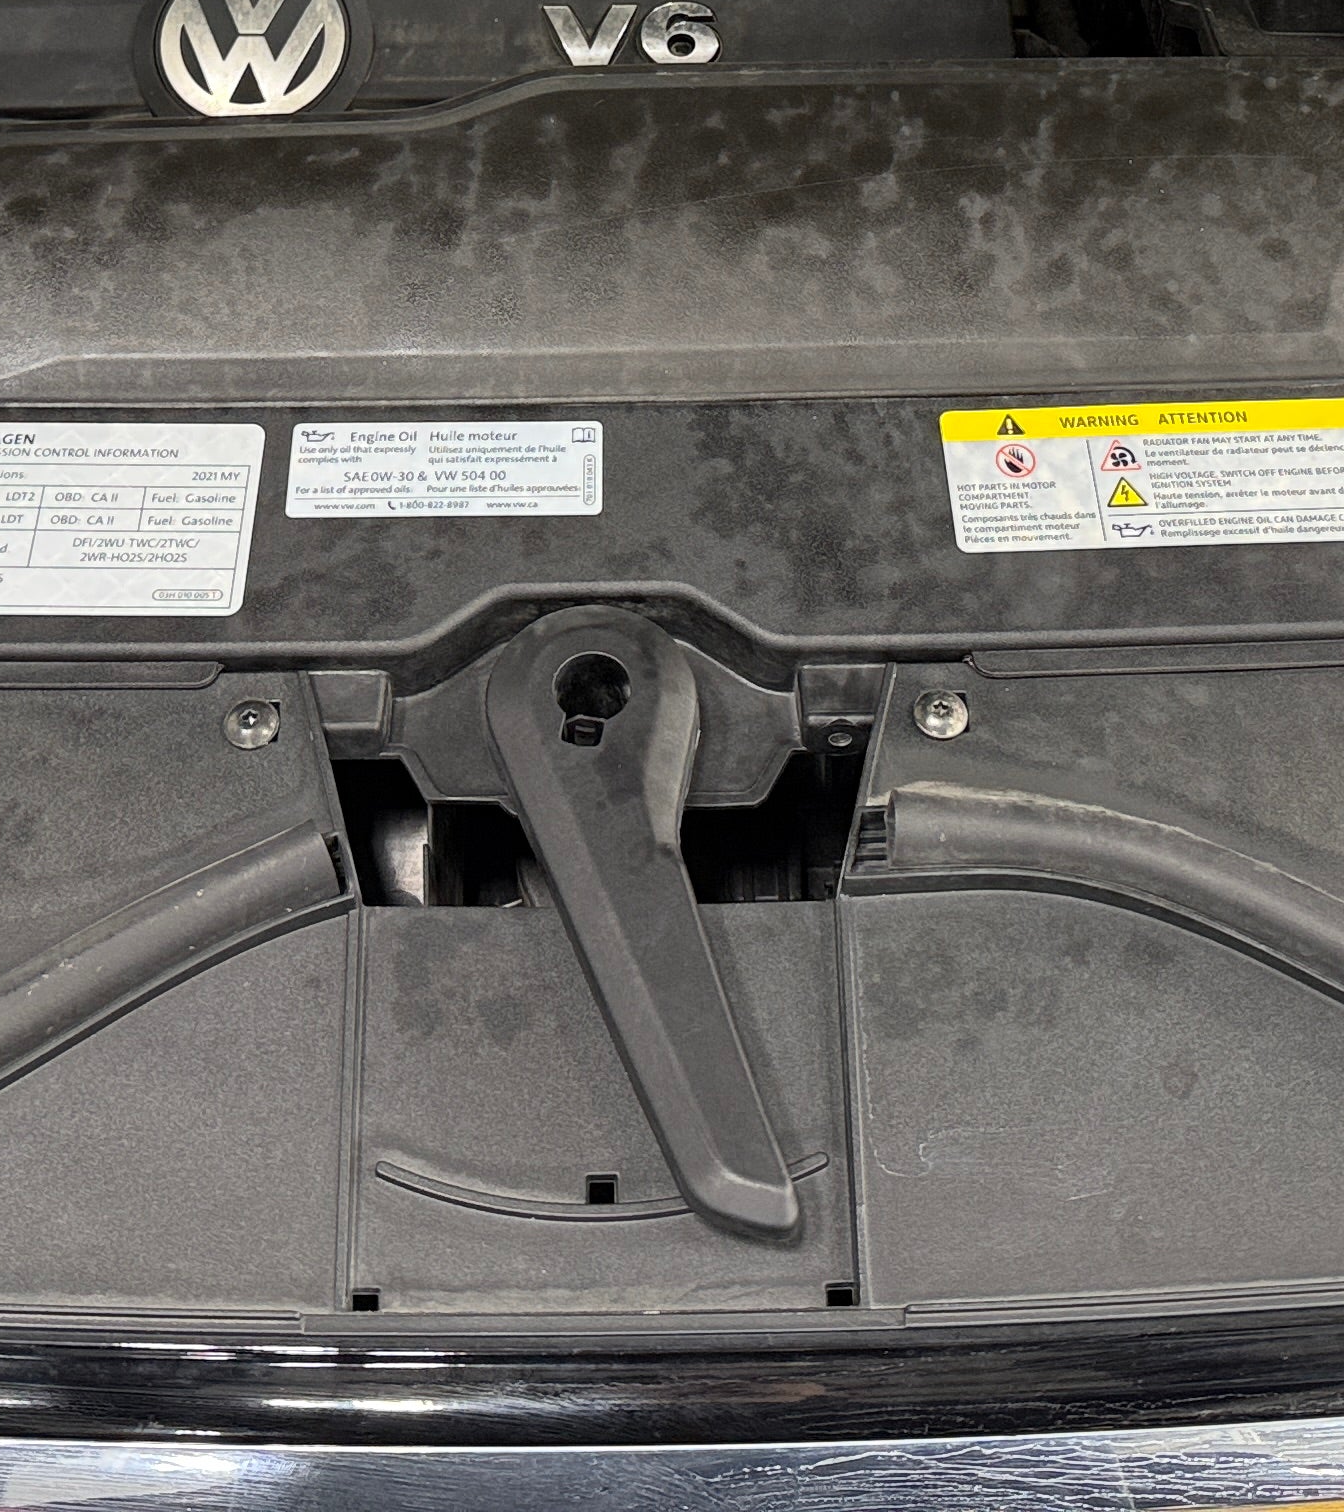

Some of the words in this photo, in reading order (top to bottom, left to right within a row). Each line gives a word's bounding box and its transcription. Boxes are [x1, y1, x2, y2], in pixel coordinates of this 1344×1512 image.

[542, 1, 722, 67] V6
[1058, 413, 1138, 428] WARNING
[1158, 410, 1247, 424] ATTENTION
[350, 431, 395, 444] Engine
[398, 430, 417, 441] Oil
[429, 430, 464, 441] Huile
[468, 430, 517, 440] moteur
[1142, 437, 1189, 446] RADIATOR
[1211, 436, 1231, 444] MAY
[1232, 435, 1261, 443] START
[1263, 434, 1274, 442] AT
[1276, 434, 1295, 442] ANY
[1296, 433, 1322, 441] TIME.
[33, 447, 89, 457] CONTROL
[93, 448, 179, 458] INFORMATION
[299, 445, 316, 453] Use
[317, 445, 338, 455] only
[339, 445, 351, 453] oil
[352, 445, 372, 453] that
[373, 444, 416, 455] expressly
[297, 455, 339, 465] complies
[340, 455, 362, 463] with
[427, 456, 443, 465] qui
[445, 454, 482, 463] satisfait
[484, 454, 549, 464] expressément
[551, 454, 557, 462] à
[191, 471, 217, 481] 2021
[220, 471, 240, 480] MY
[343, 471, 368, 482] SAE
[370, 470, 414, 482] 0W-30
[416, 470, 427, 481] &
[434, 470, 458, 481] VW
[461, 470, 485, 481] 504
[489, 469, 506, 480] 00
[956, 483, 976, 491] HOT
[978, 482, 1008, 491] PARTS
[1021, 480, 1056, 489] MOTOR
[5, 491, 35, 501] LDT2
[0, 513, 24, 523] LDT
[50, 514, 80, 524] OBD:
[86, 514, 103, 525] CA
[106, 515, 114, 525] II
[147, 515, 175, 525] Fuel:
[181, 515, 233, 526] Gasoline
[1158, 517, 1216, 527] OVERFILLED
[1217, 516, 1254, 525] ENGINE
[1255, 515, 1272, 524] OIL
[1273, 515, 1294, 523] CAN
[1295, 513, 1336, 522] DAMAGE
